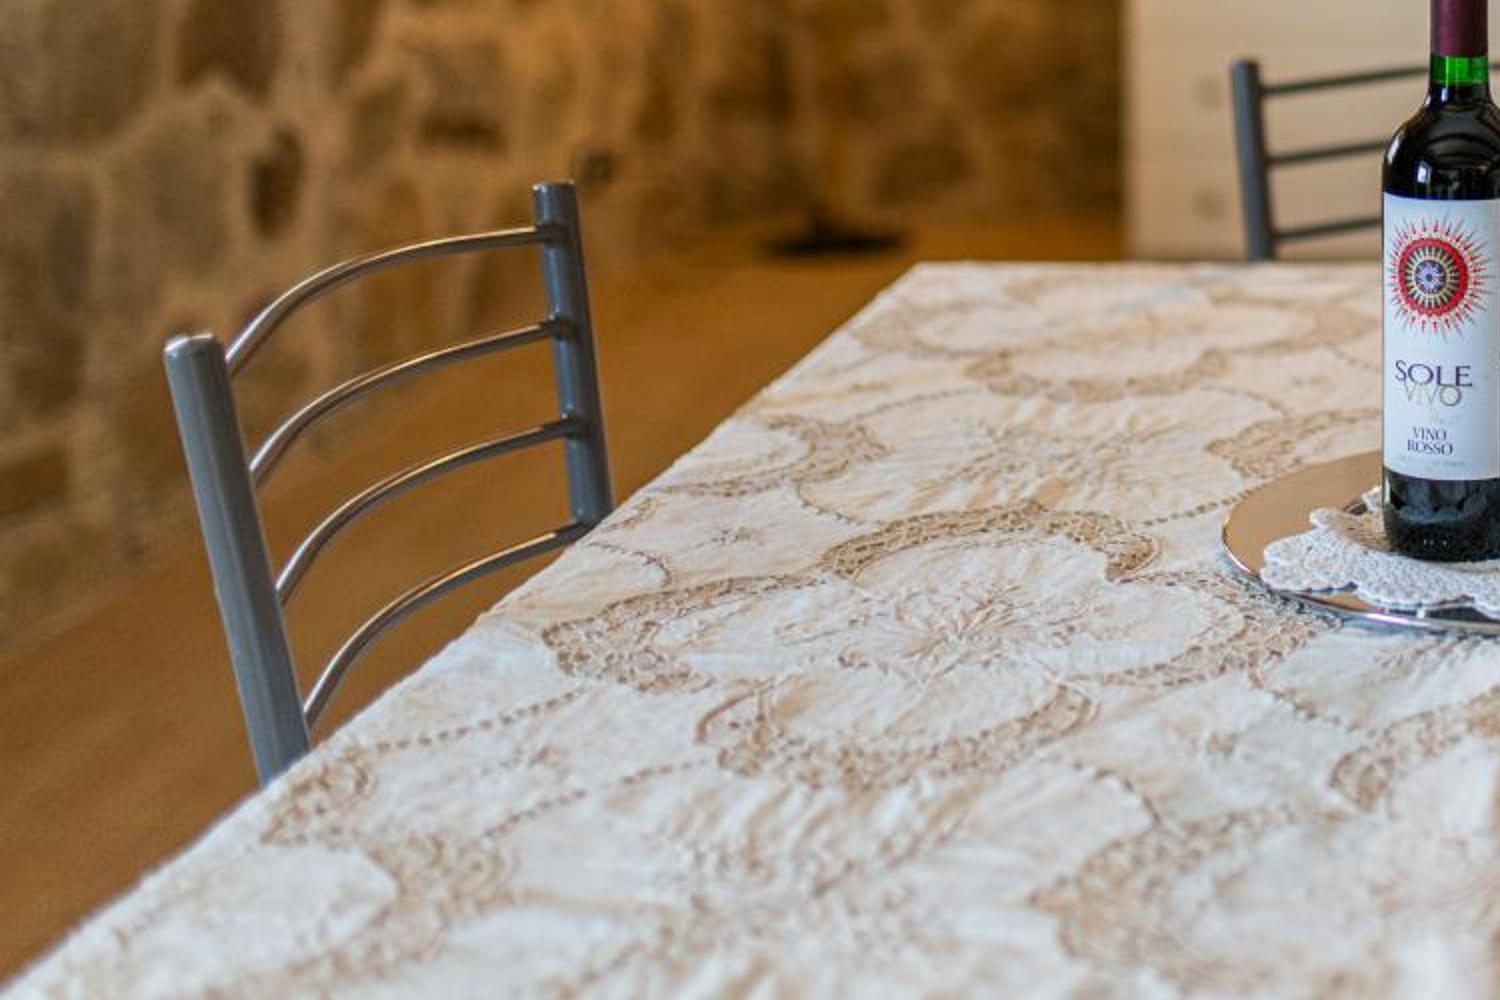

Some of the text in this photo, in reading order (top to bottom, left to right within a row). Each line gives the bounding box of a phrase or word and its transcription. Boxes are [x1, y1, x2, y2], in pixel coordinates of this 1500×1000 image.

[1395, 359, 1472, 386] SOLE
[1404, 383, 1462, 407] VIVO
[1412, 426, 1447, 440] VINO
[1407, 439, 1454, 456] ROSSO
